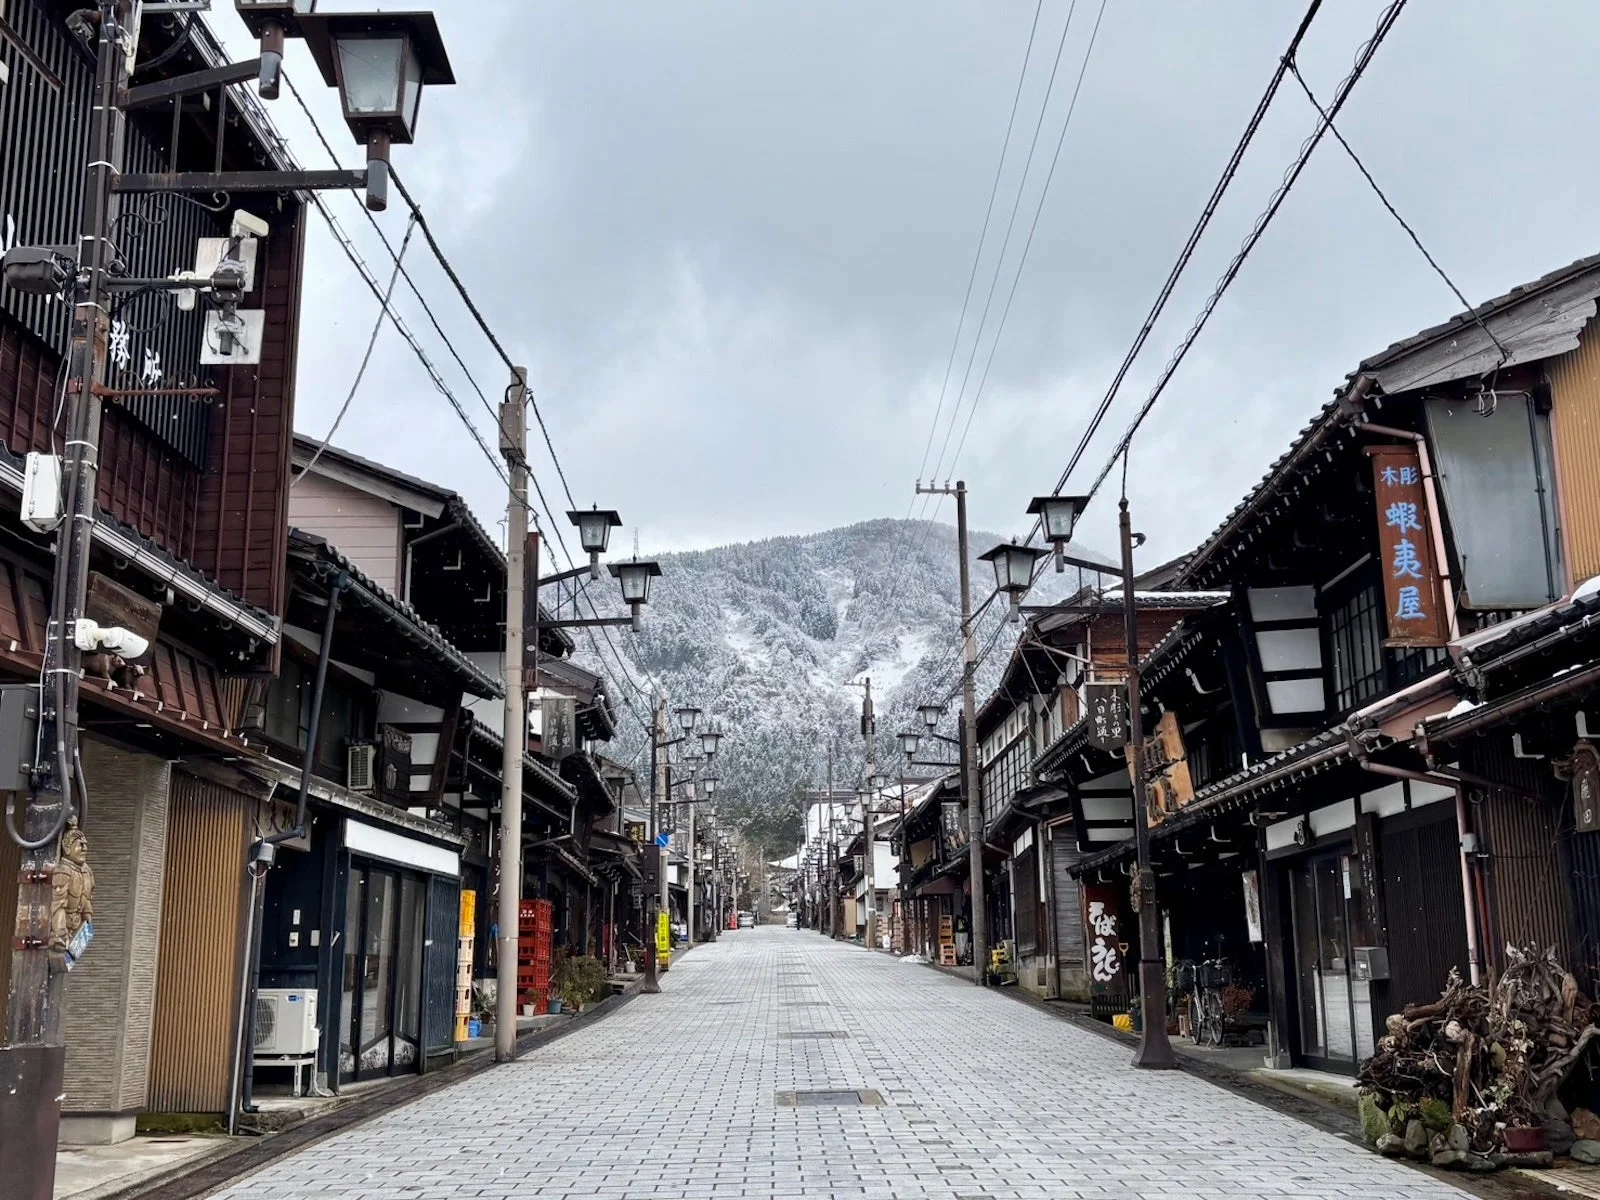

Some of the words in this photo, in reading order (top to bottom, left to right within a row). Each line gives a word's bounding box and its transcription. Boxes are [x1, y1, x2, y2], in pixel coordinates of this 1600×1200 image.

[1380, 466, 1419, 487] 木彫
[1385, 501, 1428, 621] 蝦夷屋
